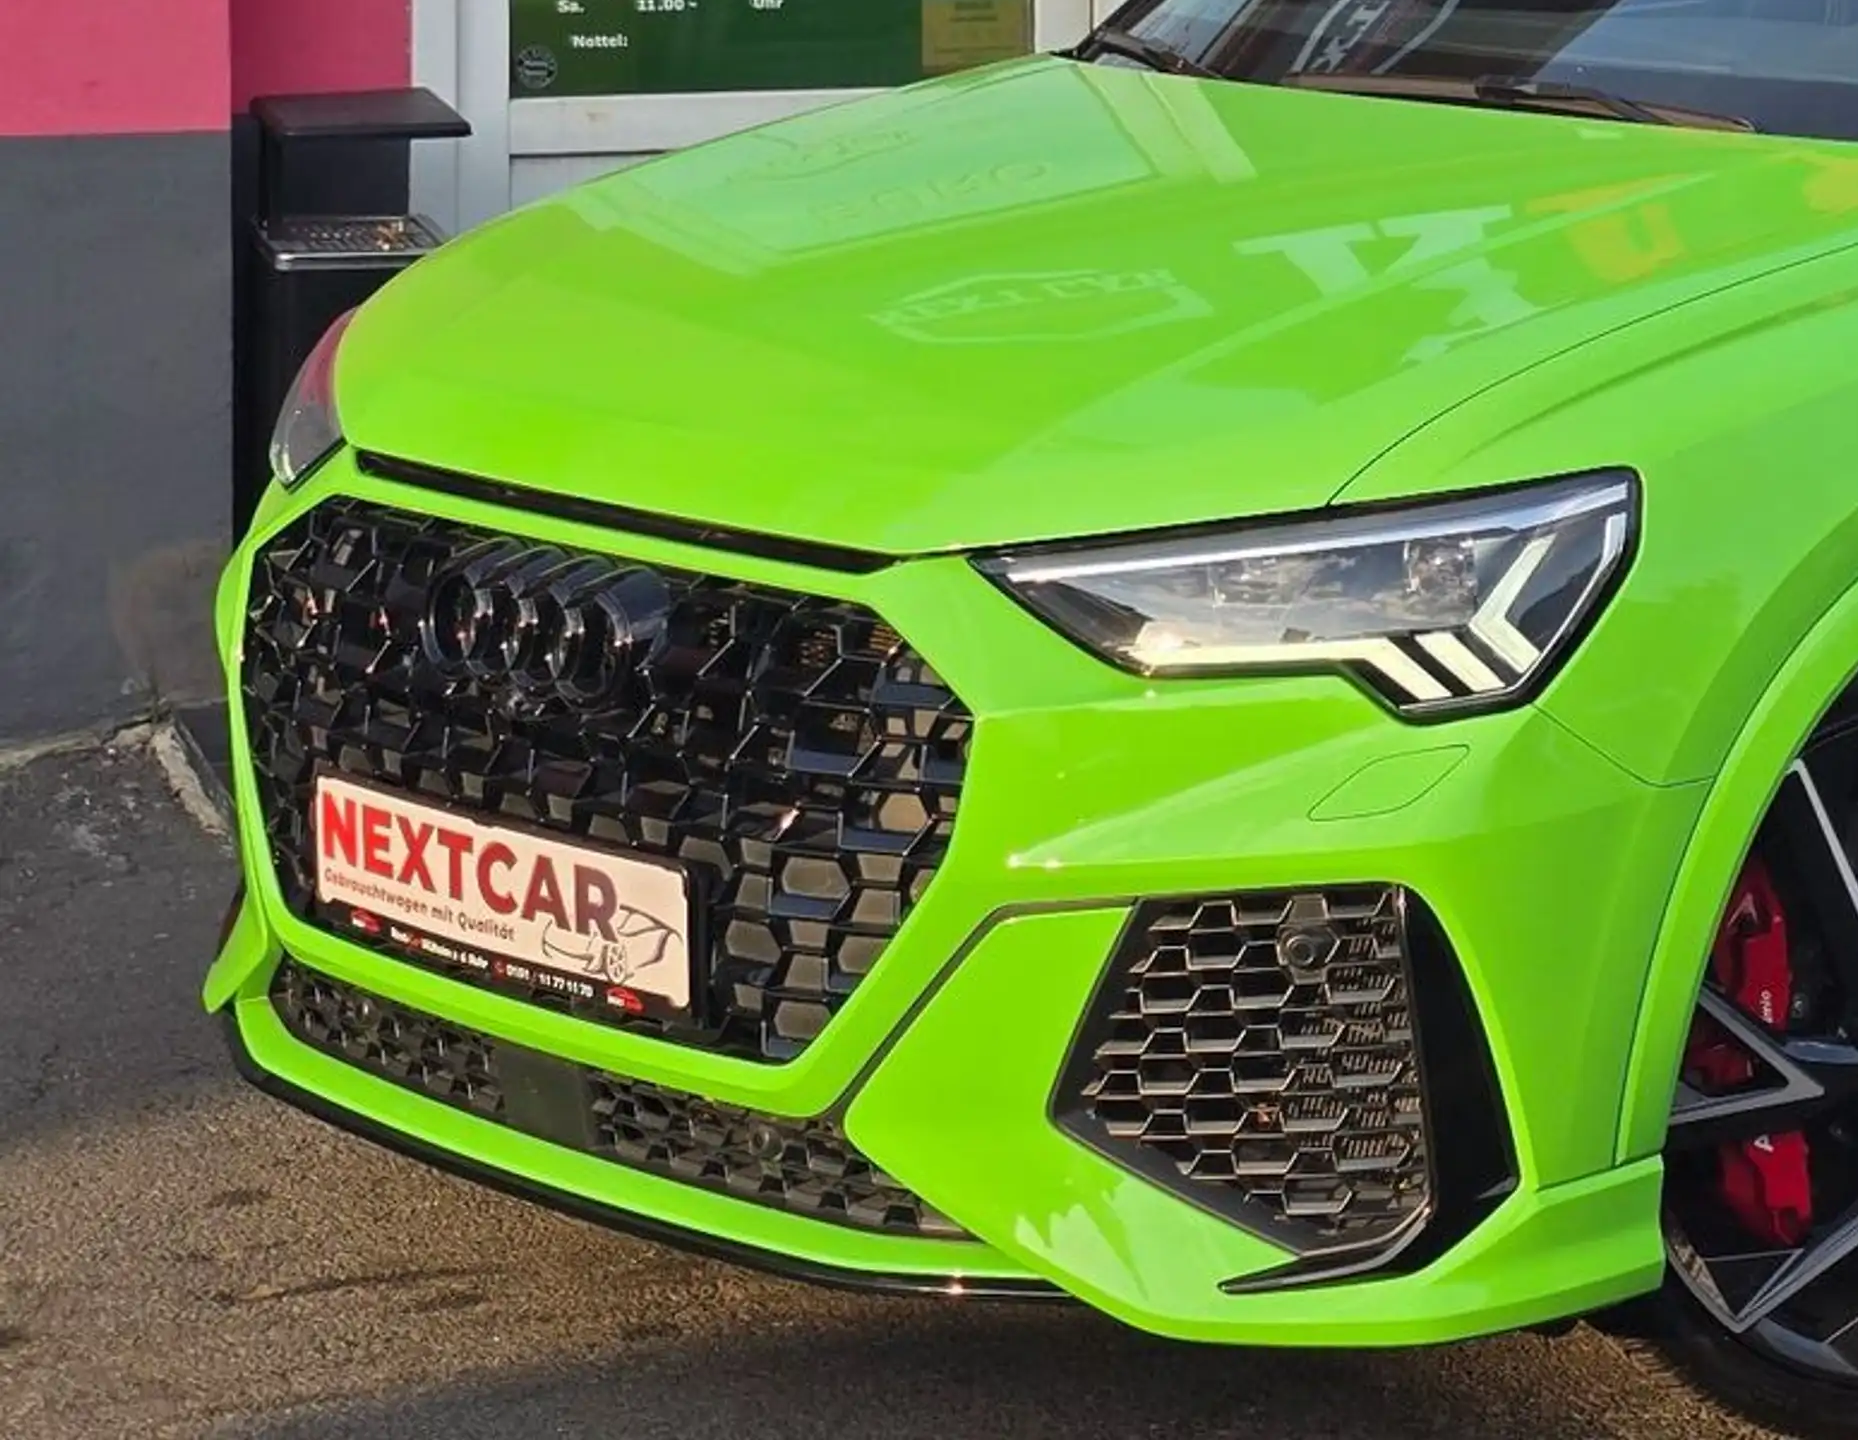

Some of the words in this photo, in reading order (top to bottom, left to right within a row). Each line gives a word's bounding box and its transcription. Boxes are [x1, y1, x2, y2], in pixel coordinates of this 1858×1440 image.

[322, 789, 618, 942] NEXTCAR
[323, 867, 431, 914] Gebrauchtwagen
[432, 904, 454, 923] mit
[457, 911, 516, 941] Qualität
